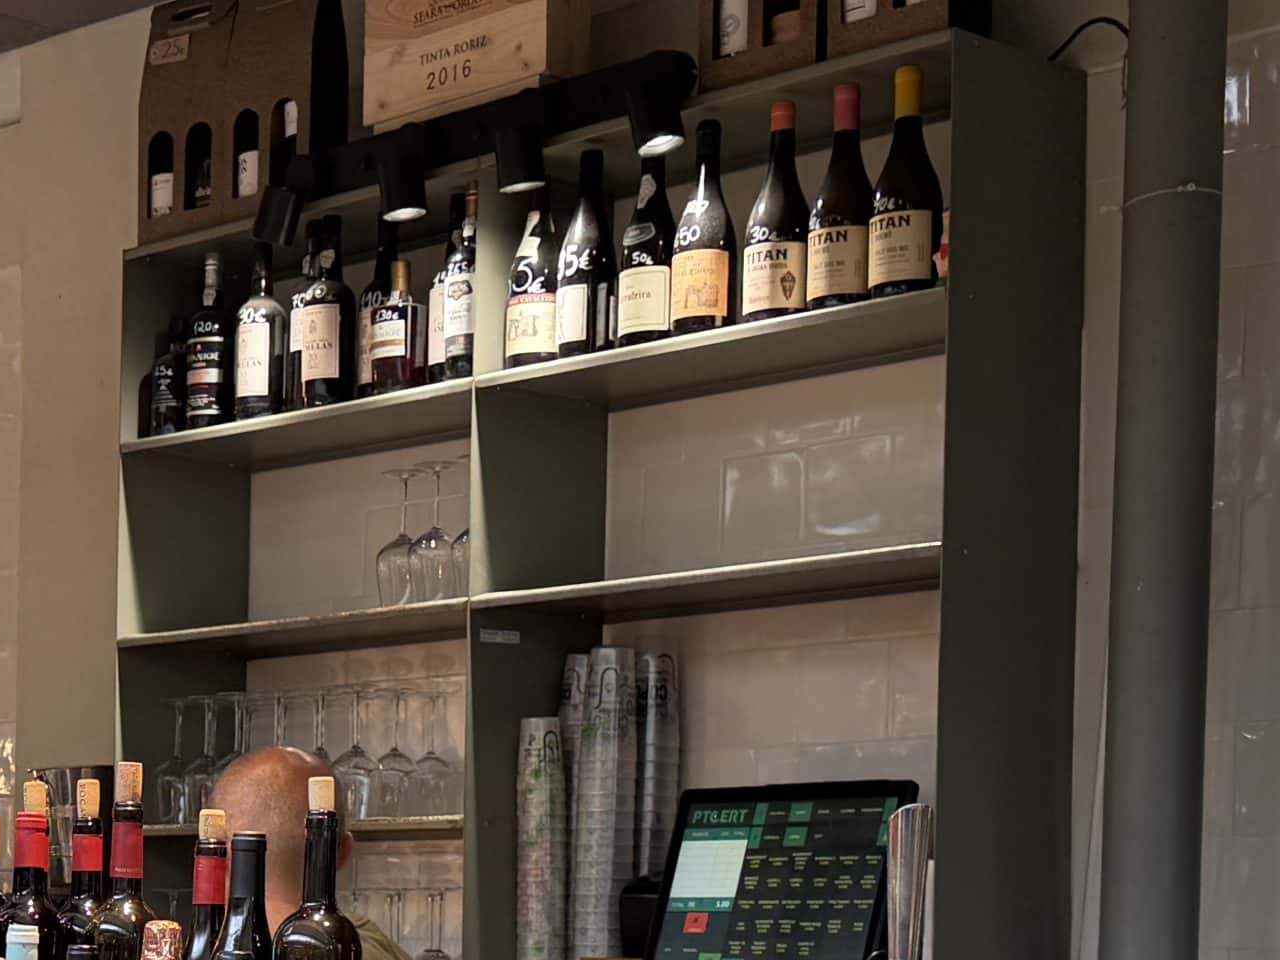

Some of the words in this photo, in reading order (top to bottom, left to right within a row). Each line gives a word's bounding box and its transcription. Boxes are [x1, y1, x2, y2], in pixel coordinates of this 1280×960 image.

[420, 48, 451, 66] TINTA
[454, 35, 488, 56] RORIZ
[426, 59, 472, 90] 2016
[870, 214, 912, 234] TITAN
[808, 229, 849, 246] TITAN
[746, 247, 789, 262] TITAN
